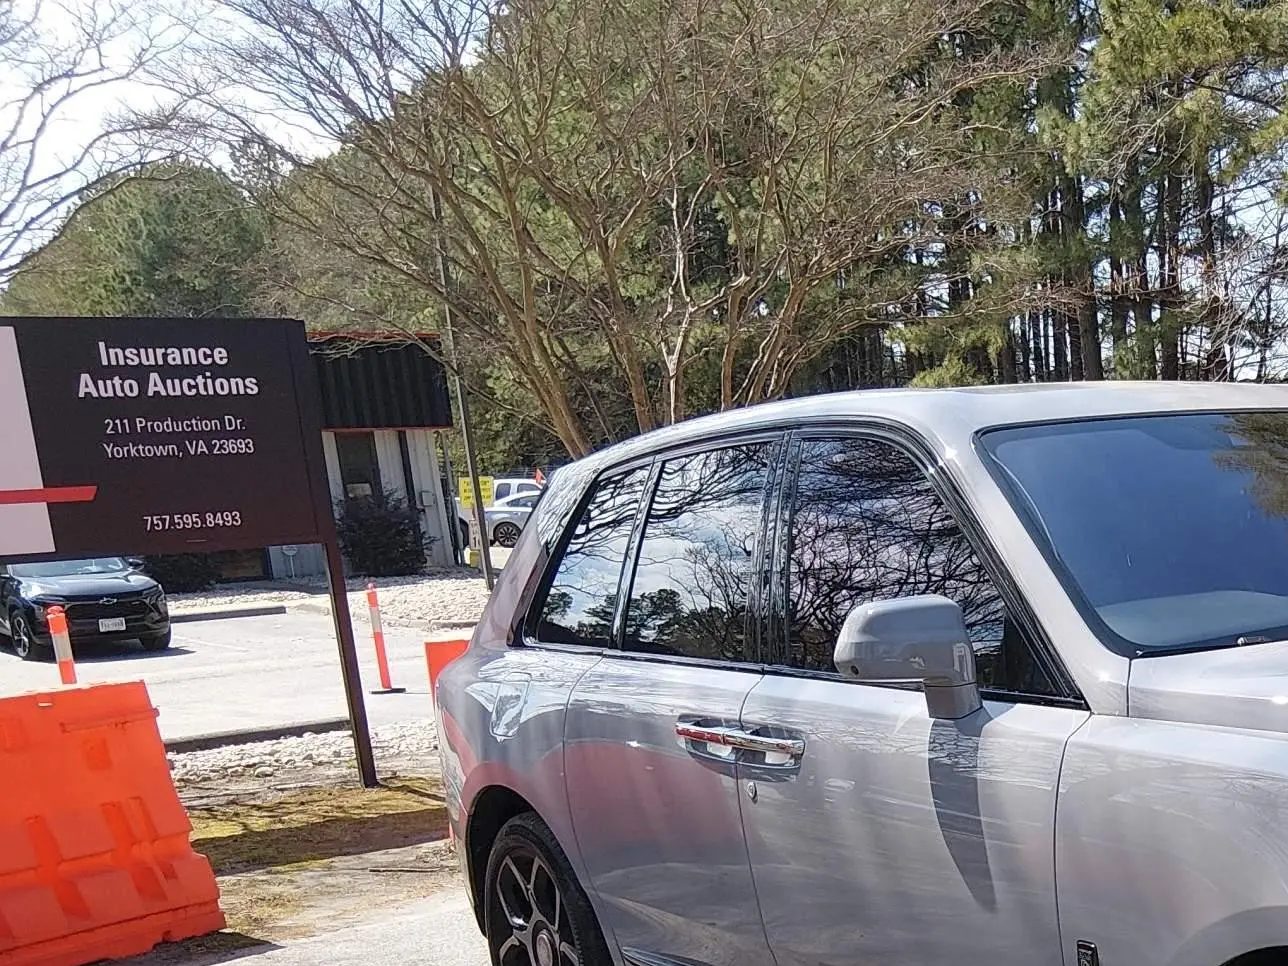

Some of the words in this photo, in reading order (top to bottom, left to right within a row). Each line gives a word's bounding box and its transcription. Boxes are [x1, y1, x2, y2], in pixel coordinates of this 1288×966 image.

[98, 341, 229, 366] Insurance
[78, 373, 139, 398] Auto
[147, 371, 259, 397] Auctions
[104, 418, 130, 434] 211
[135, 416, 221, 433] Production
[224, 415, 246, 431] Dr.
[102, 442, 183, 458] Yorktown,
[185, 439, 209, 455] VA
[211, 438, 254, 454] 23693
[143, 511, 242, 531] 757.595.8493
